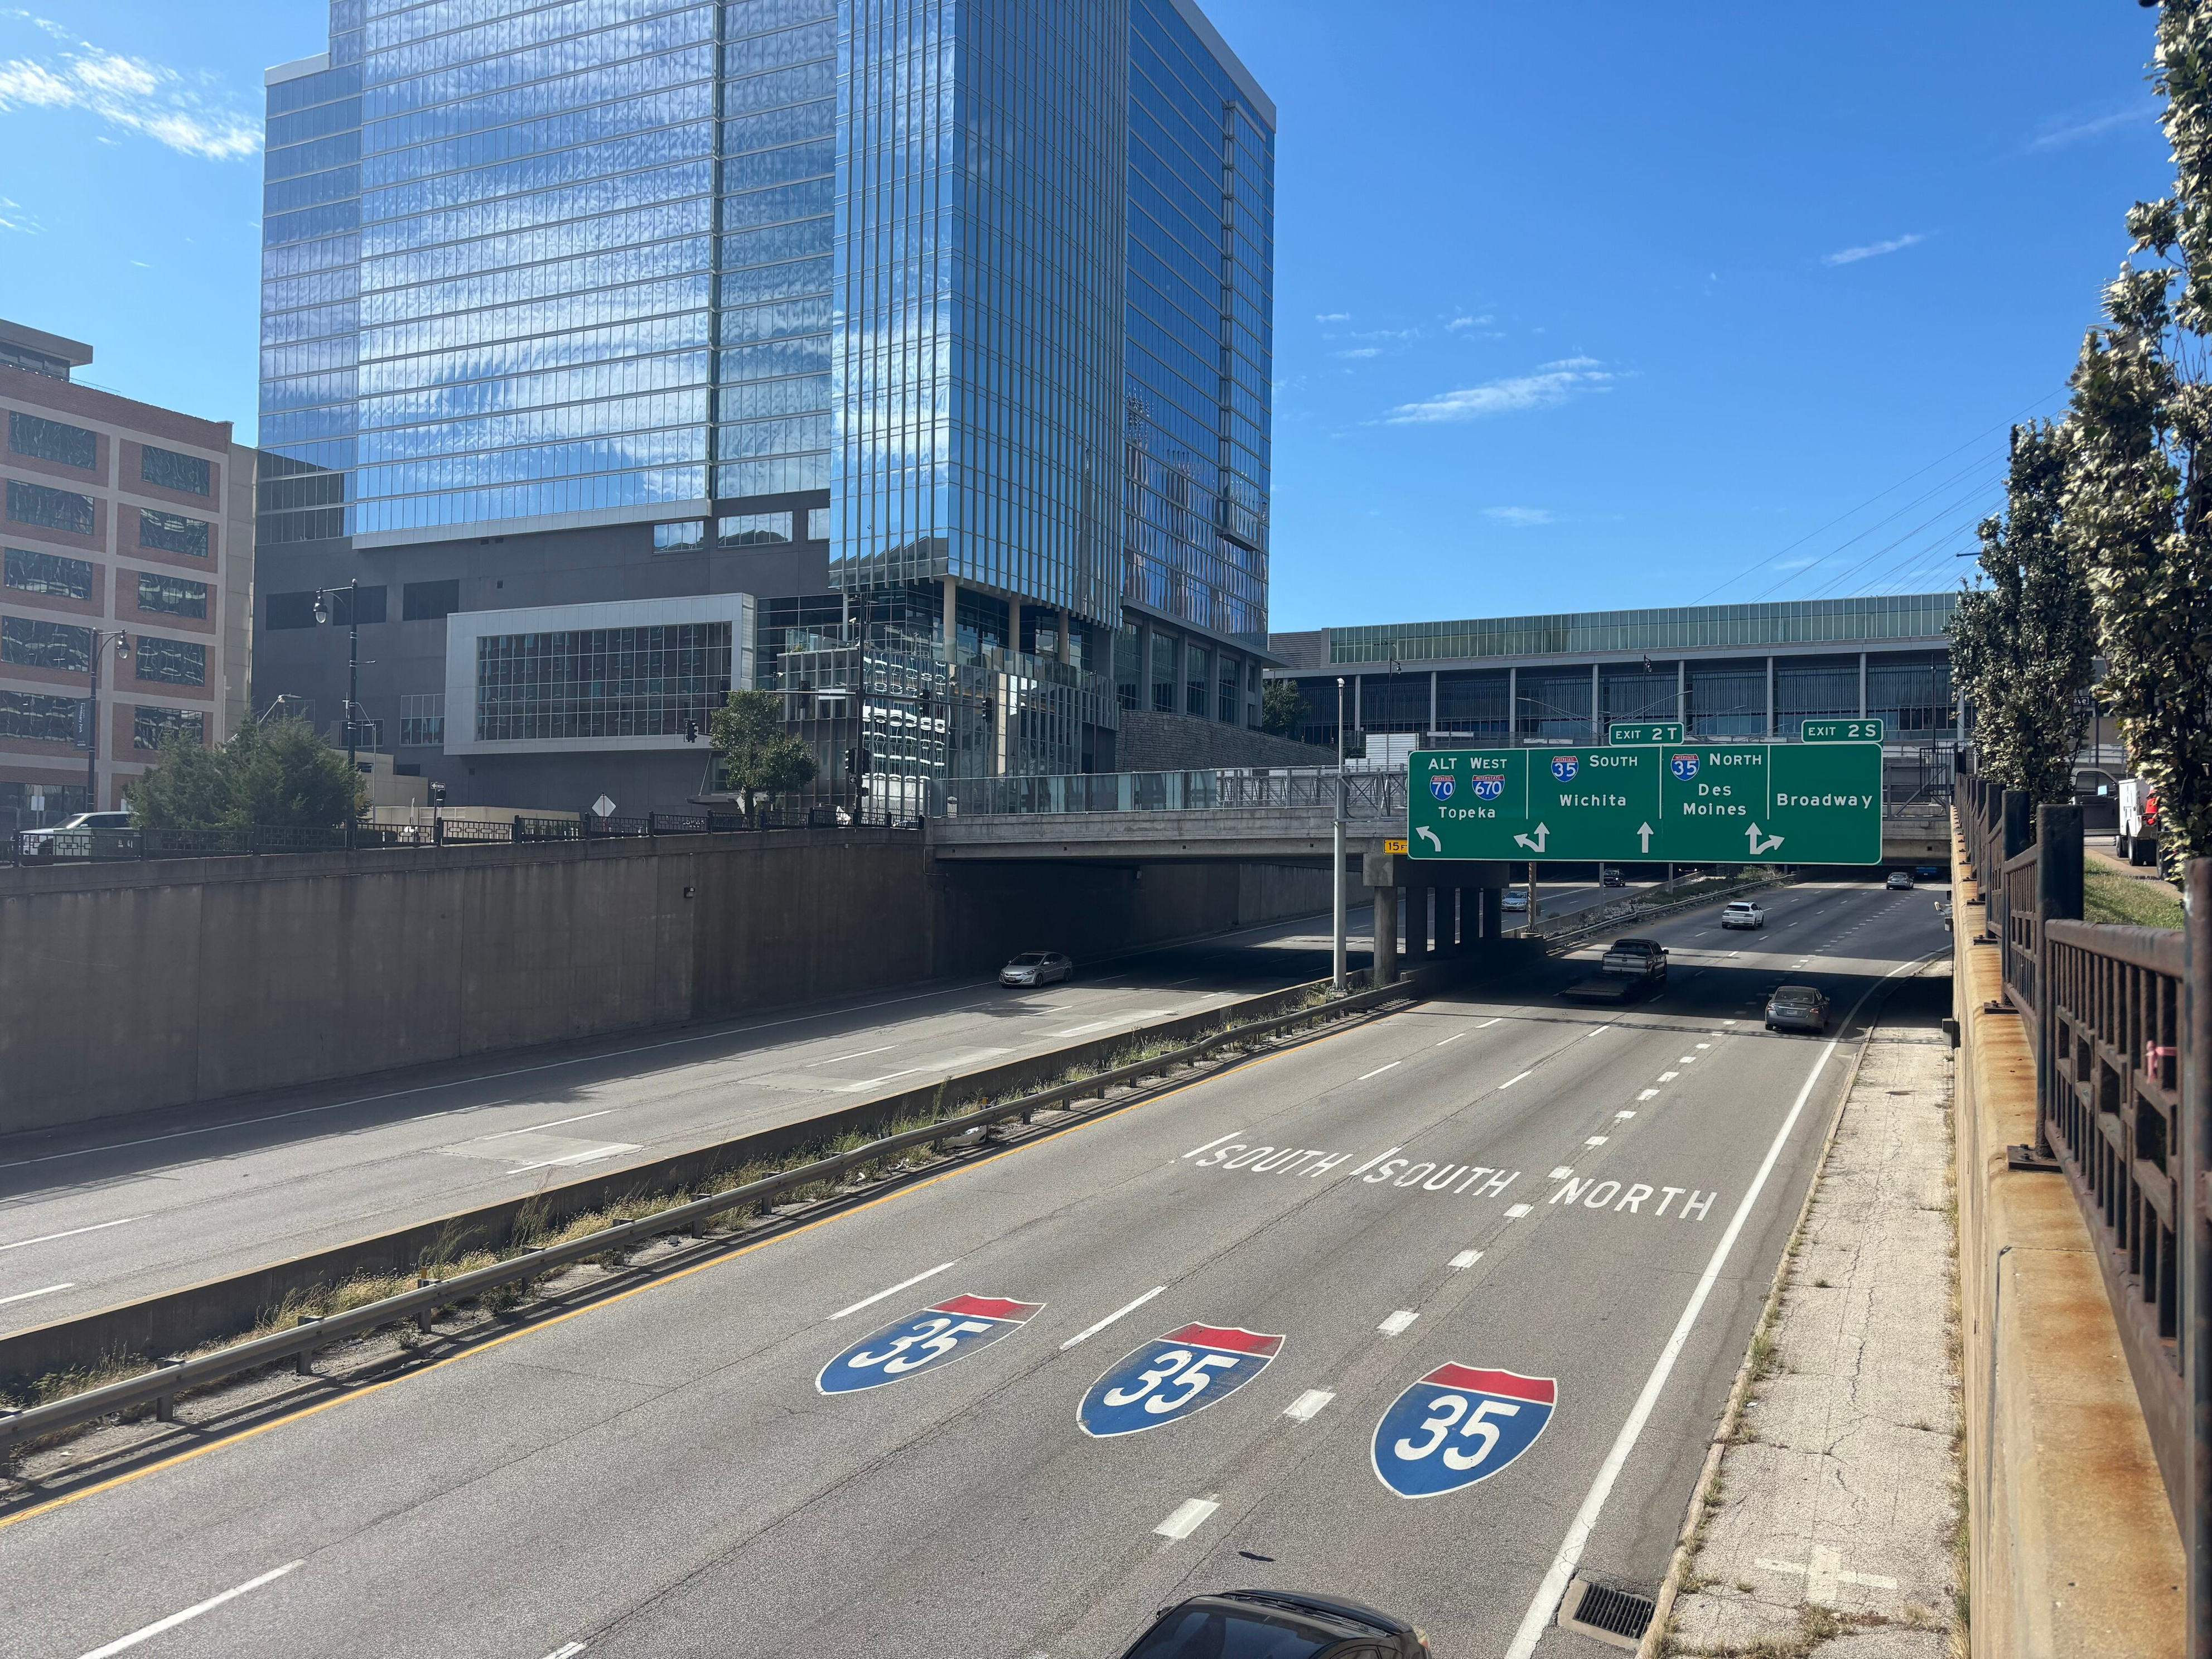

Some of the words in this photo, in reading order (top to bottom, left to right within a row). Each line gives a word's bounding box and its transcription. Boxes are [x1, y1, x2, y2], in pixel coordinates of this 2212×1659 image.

[1616, 730, 1641, 739] EXIT
[1809, 727, 1836, 736] EXIT
[1428, 758, 1457, 769] ALT
[1470, 758, 1507, 769] WEST
[1590, 755, 1638, 766] SOUTH
[1709, 753, 1761, 765] NORTH
[1554, 763, 1576, 777] 35
[1674, 761, 1697, 775] 35
[1432, 782, 1453, 795] 70
[1475, 781, 1501, 795] 670
[1698, 784, 1731, 796] Des
[1560, 794, 1626, 806] Wichita
[1777, 793, 1872, 808] Broadway
[1438, 807, 1495, 820] Topeka
[1683, 803, 1746, 815] Moines
[1388, 842, 1399, 851] 15
[1196, 1145, 1354, 1177] SOUTH
[1363, 1159, 1522, 1198] SOUTH
[1548, 1177, 1717, 1221] NORTH
[848, 1318, 993, 1373] 35
[1103, 1350, 1240, 1414] 35
[1394, 1395, 1520, 1470] 35
